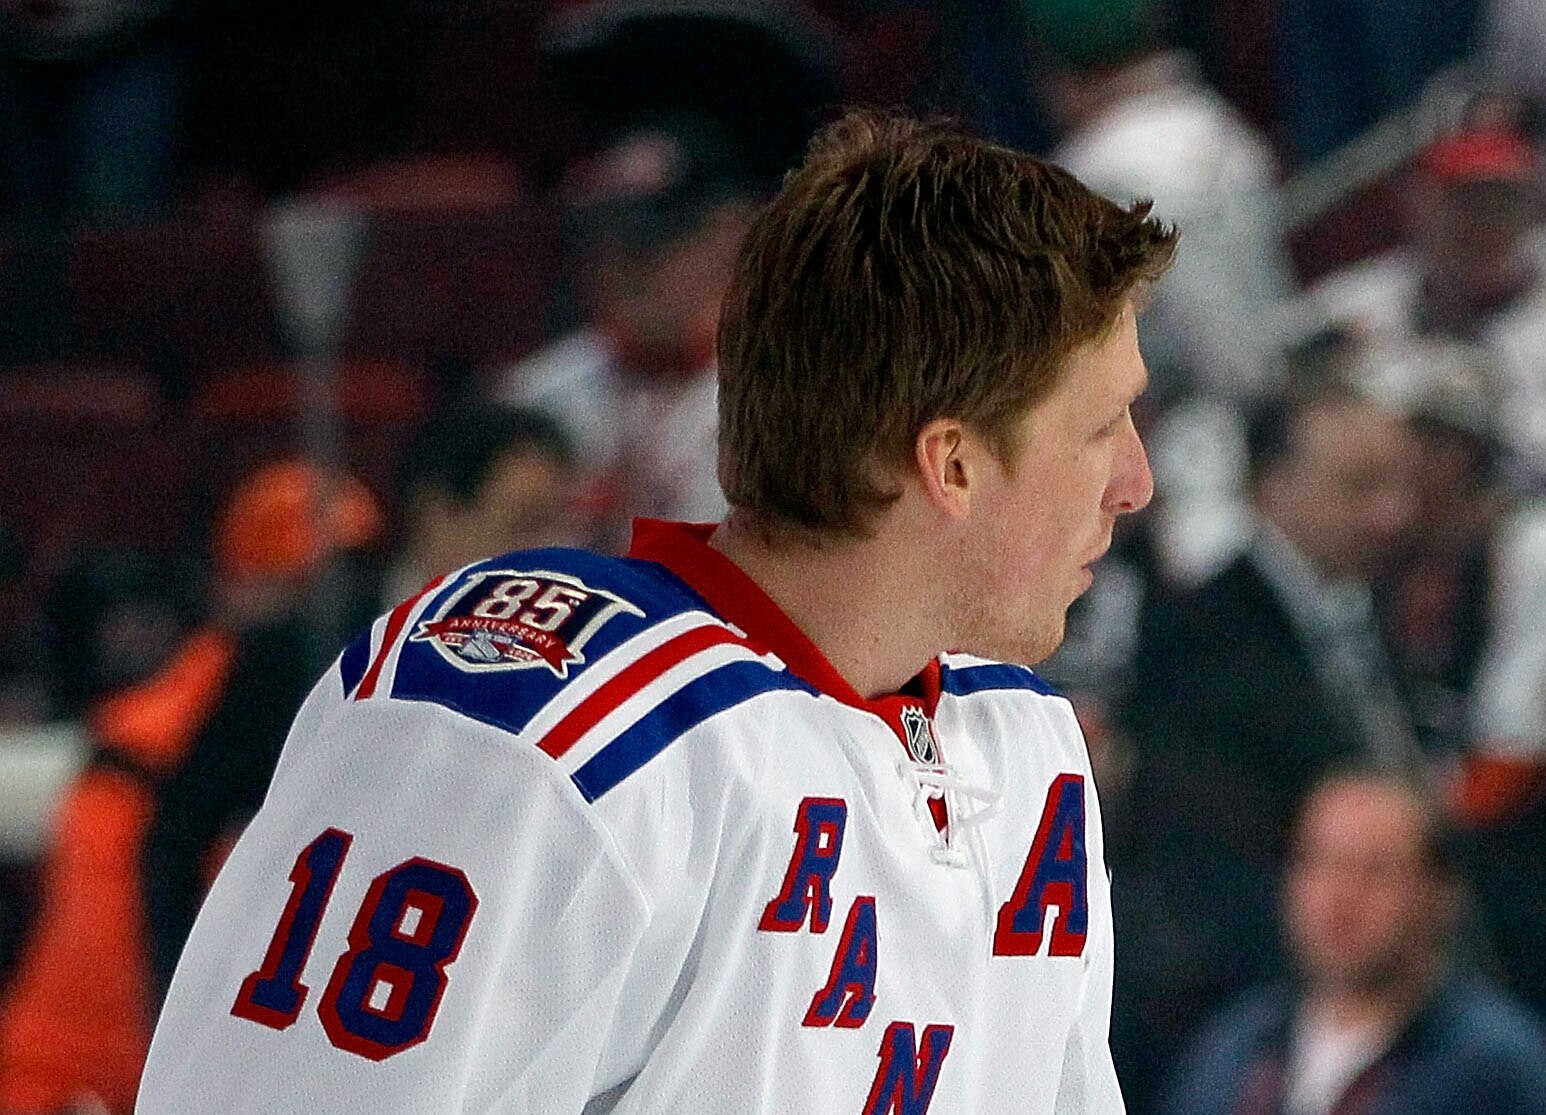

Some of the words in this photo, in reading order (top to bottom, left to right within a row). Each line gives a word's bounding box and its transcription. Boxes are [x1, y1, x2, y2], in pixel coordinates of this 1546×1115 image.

[449, 617, 557, 649] ANNIVERSARY
[231, 827, 480, 1062] 18
[993, 773, 1089, 957] A
